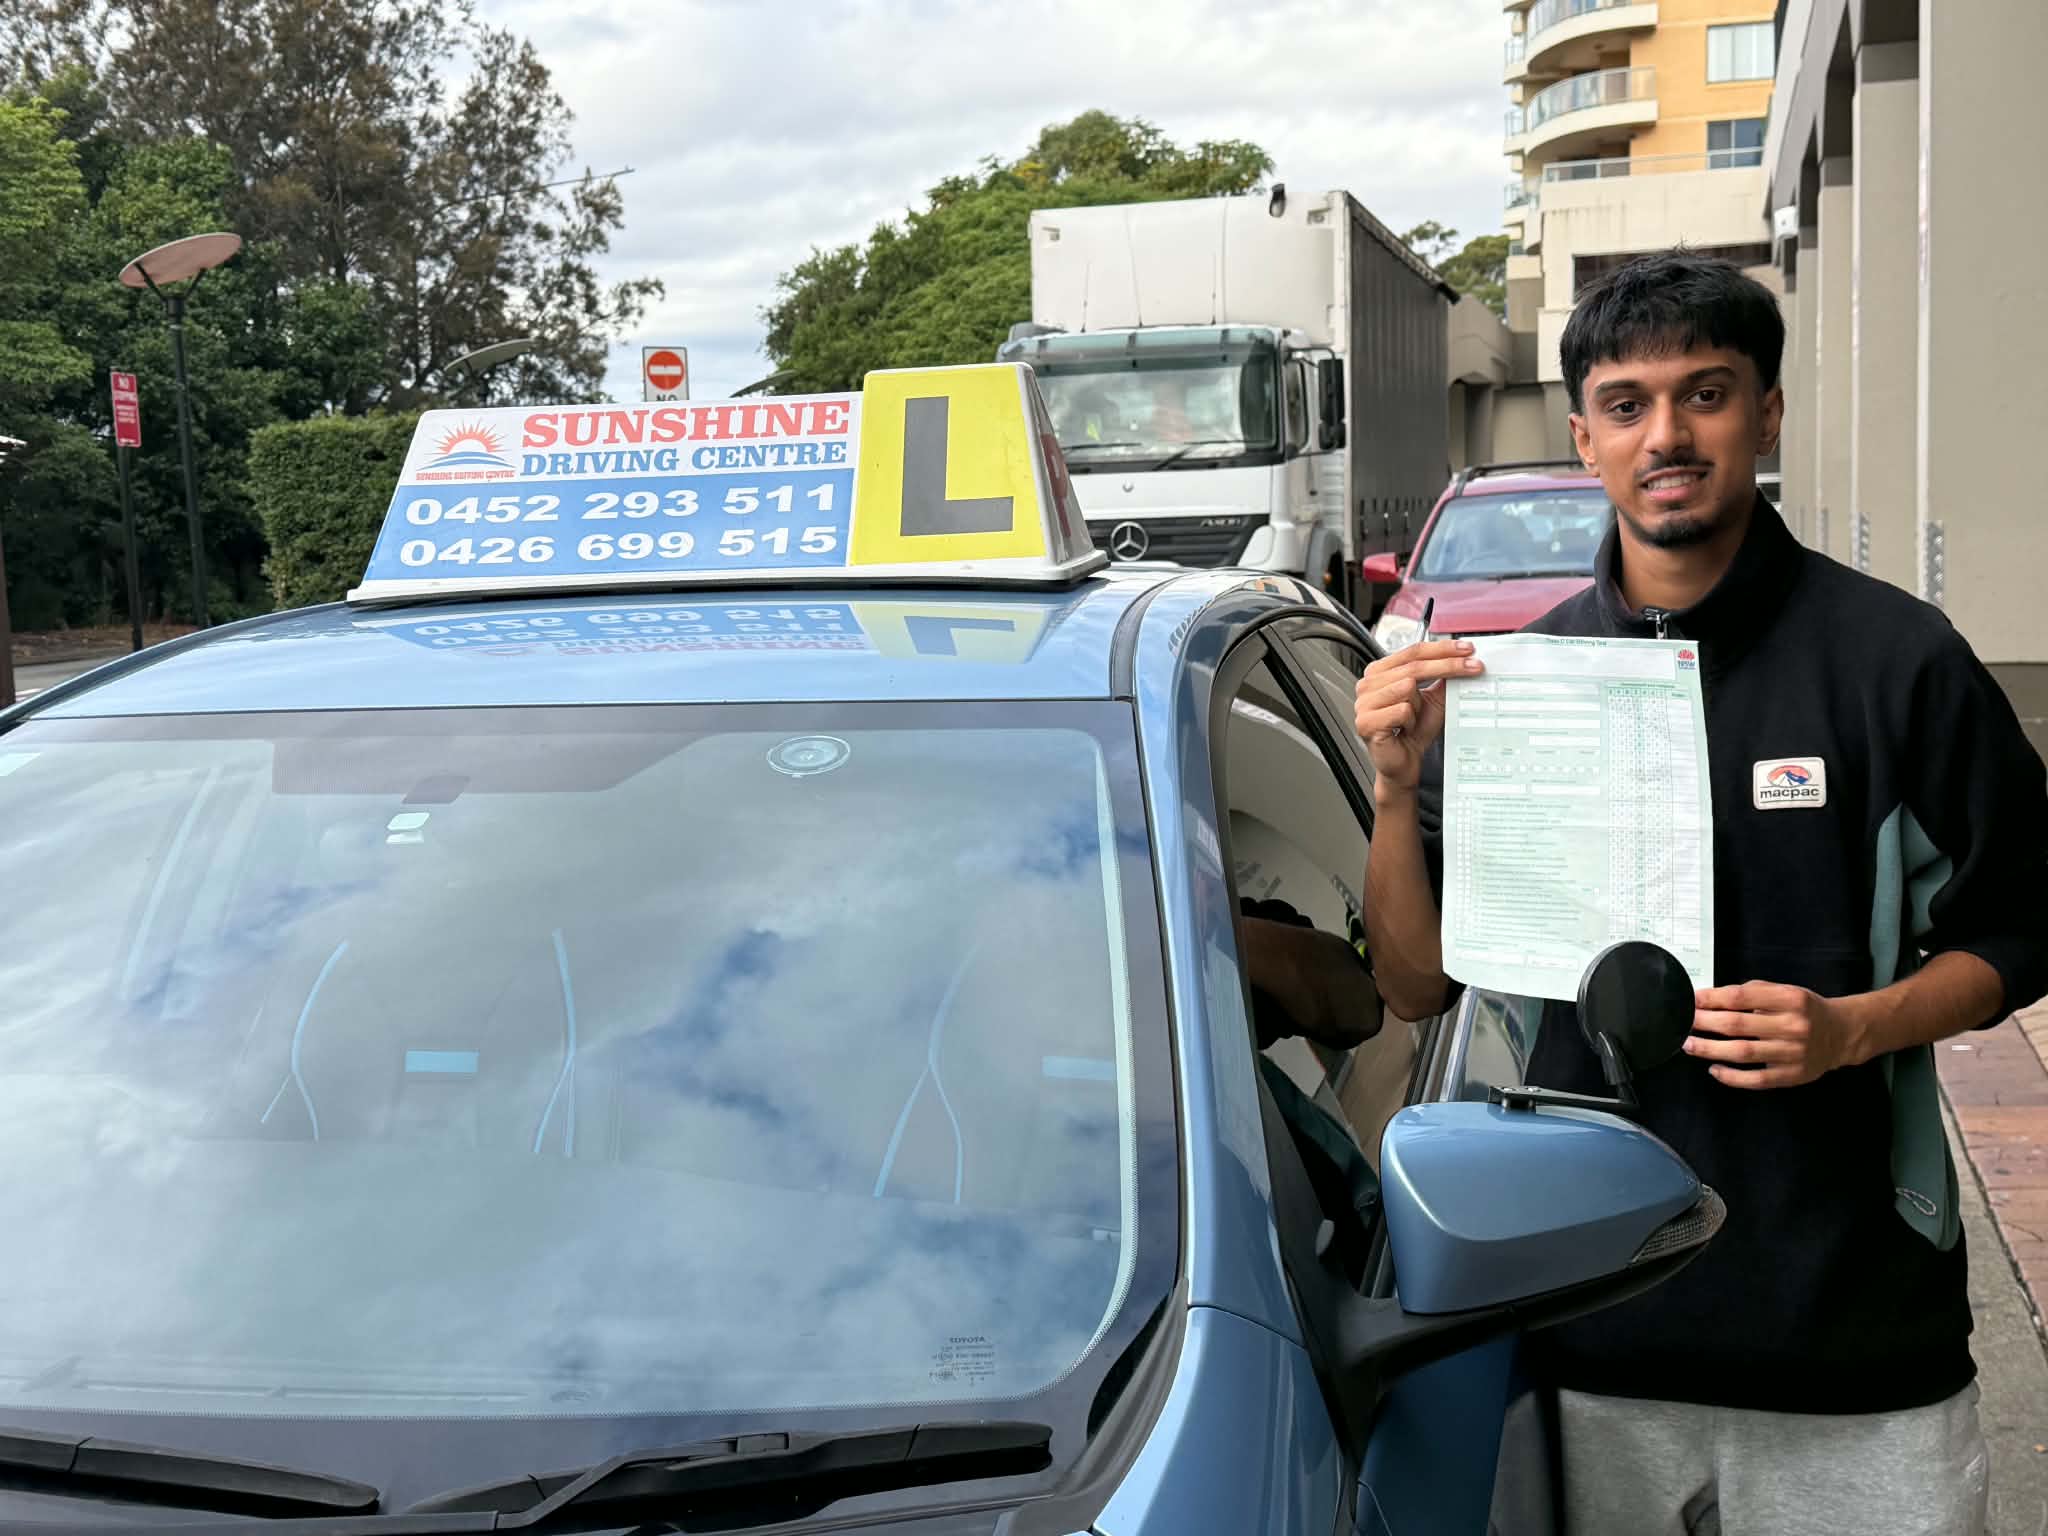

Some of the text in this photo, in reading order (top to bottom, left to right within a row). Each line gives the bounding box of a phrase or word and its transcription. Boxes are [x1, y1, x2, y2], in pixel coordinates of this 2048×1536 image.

[521, 401, 850, 448] SUNSHINE
[520, 441, 847, 476] DRIVING CENTRE
[900, 396, 1014, 536] L
[406, 483, 834, 526] 0452 293 511
[400, 526, 838, 567] 0426 699 515
[1760, 788, 1820, 799] macpac
[949, 1336, 986, 1344] TOYOTA
